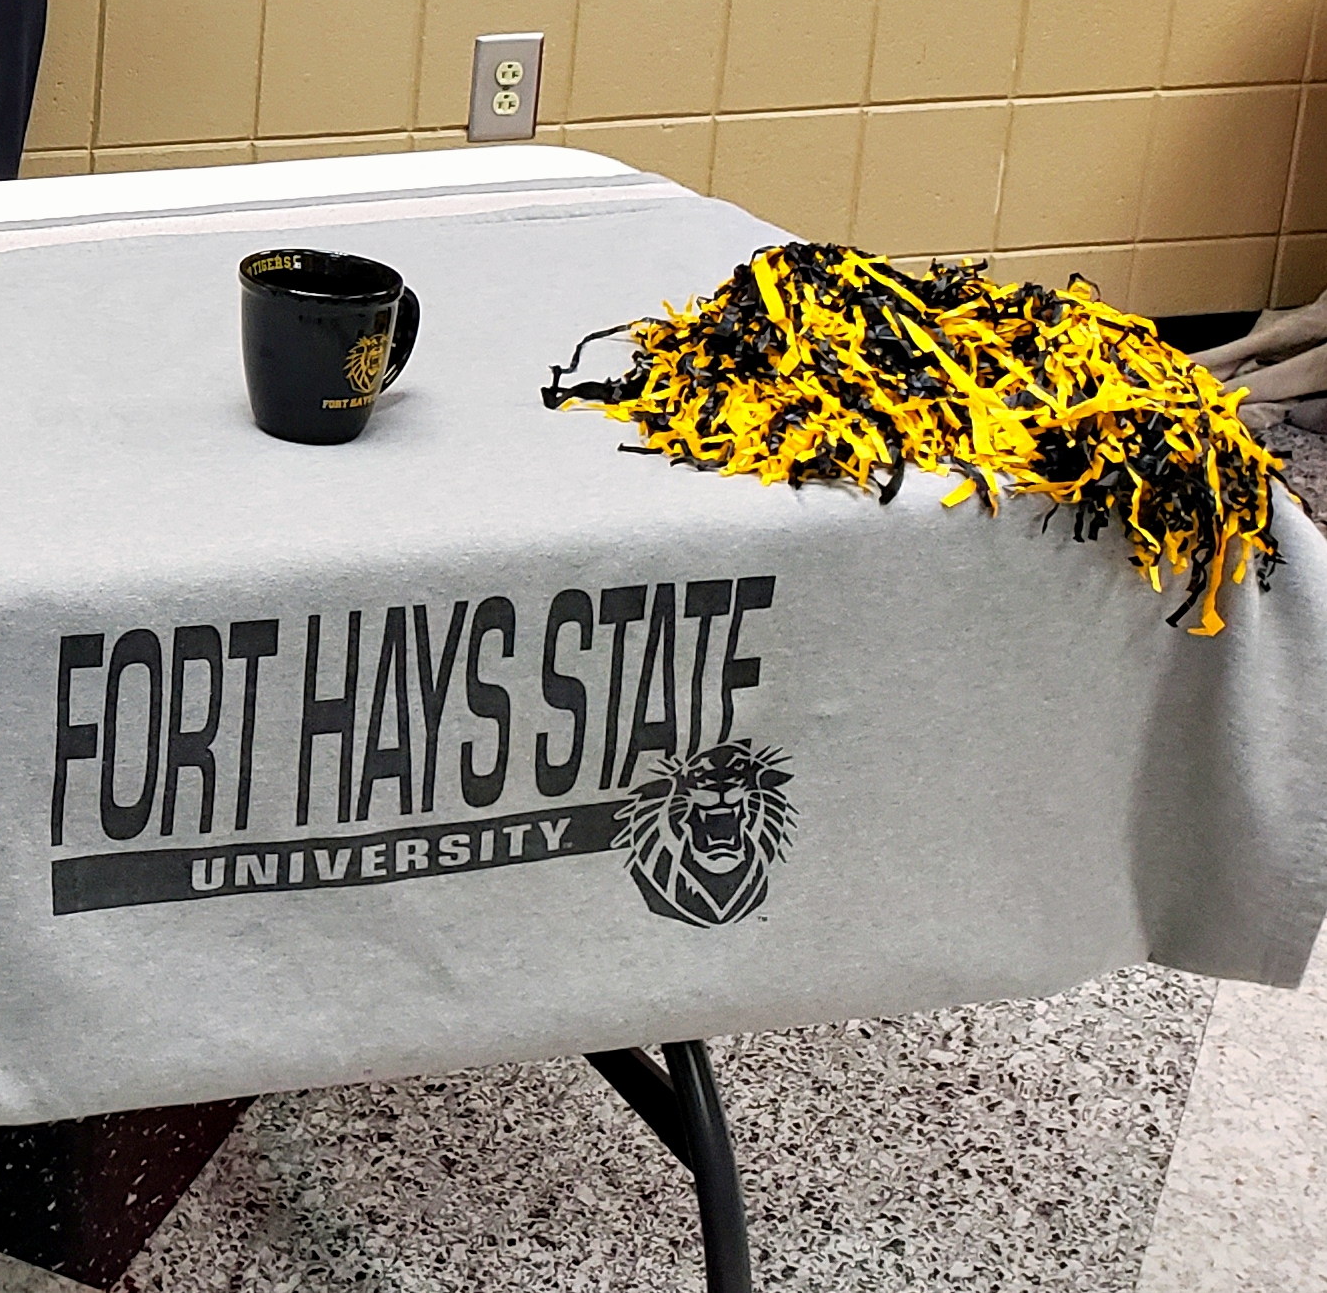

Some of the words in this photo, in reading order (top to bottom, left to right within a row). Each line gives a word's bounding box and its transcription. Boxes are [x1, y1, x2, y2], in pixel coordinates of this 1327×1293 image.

[251, 255, 292, 276] TIGERS
[51, 618, 280, 847] FORT
[296, 594, 517, 827] HAYS
[535, 575, 777, 797] STATE
[190, 815, 572, 893] UNIVERSITY
